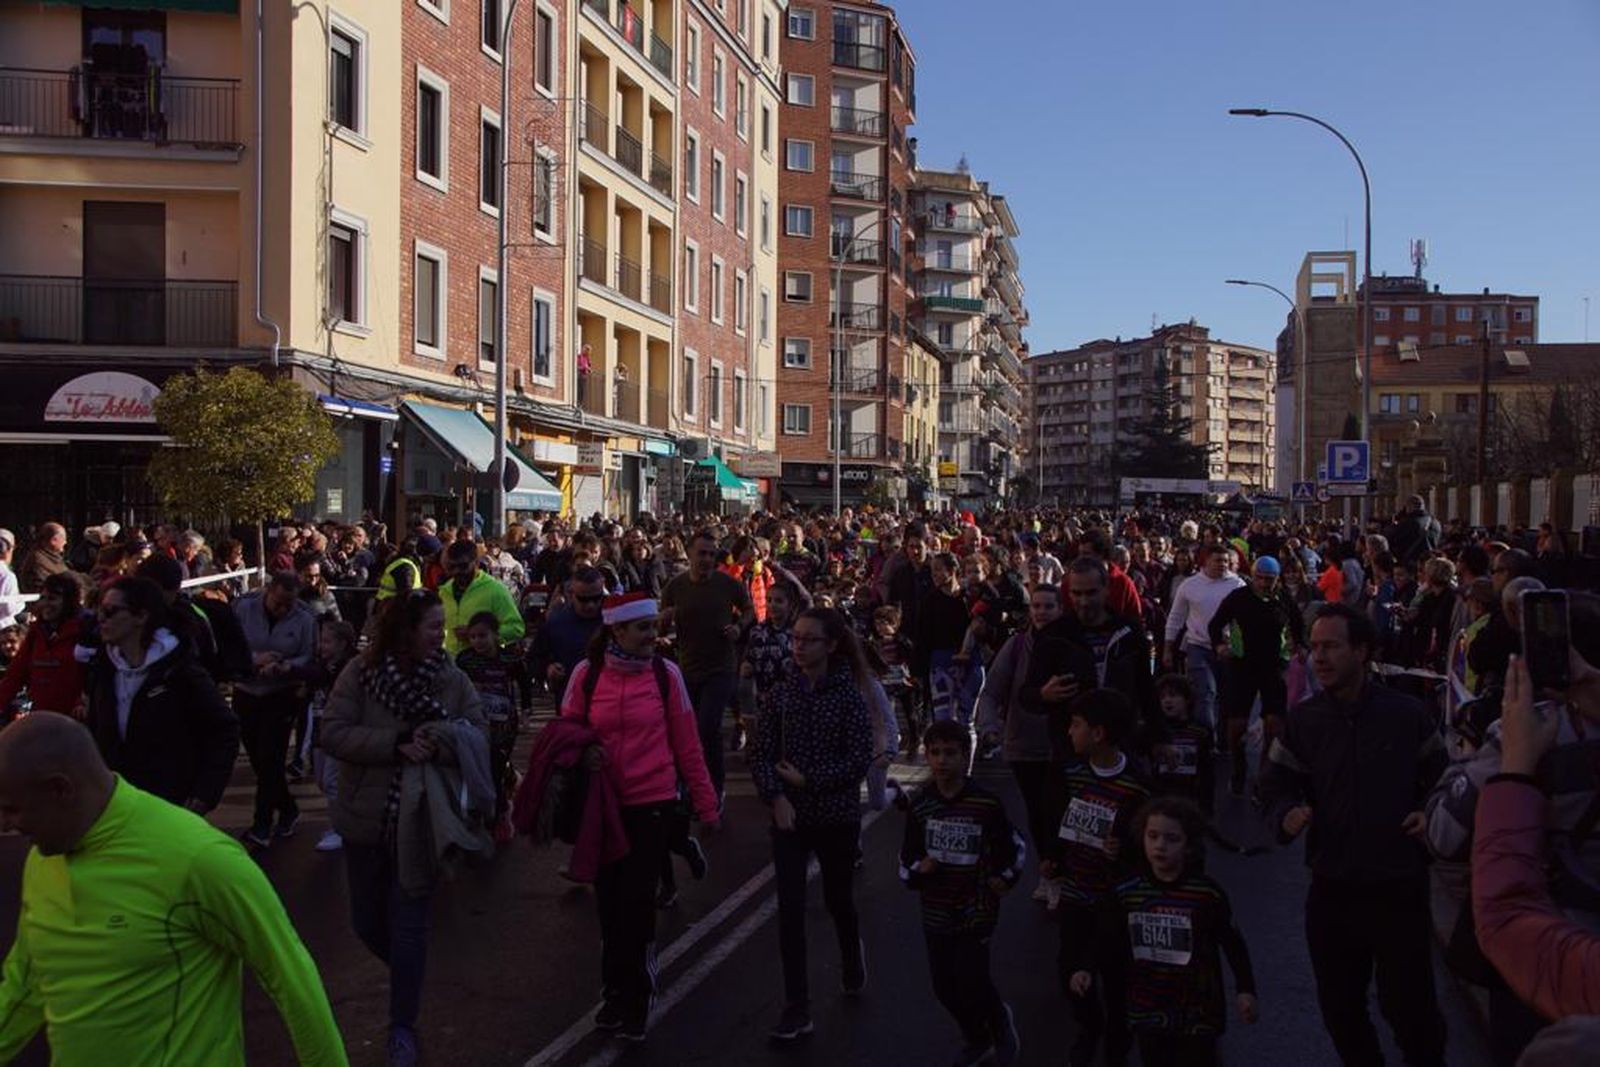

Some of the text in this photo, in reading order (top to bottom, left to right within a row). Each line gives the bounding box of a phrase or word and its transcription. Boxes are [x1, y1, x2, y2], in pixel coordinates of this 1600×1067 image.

[1335, 447, 1360, 477] P
[1066, 810, 1099, 833] 6324
[933, 832, 968, 851] 6323
[1142, 923, 1172, 947] 6141
